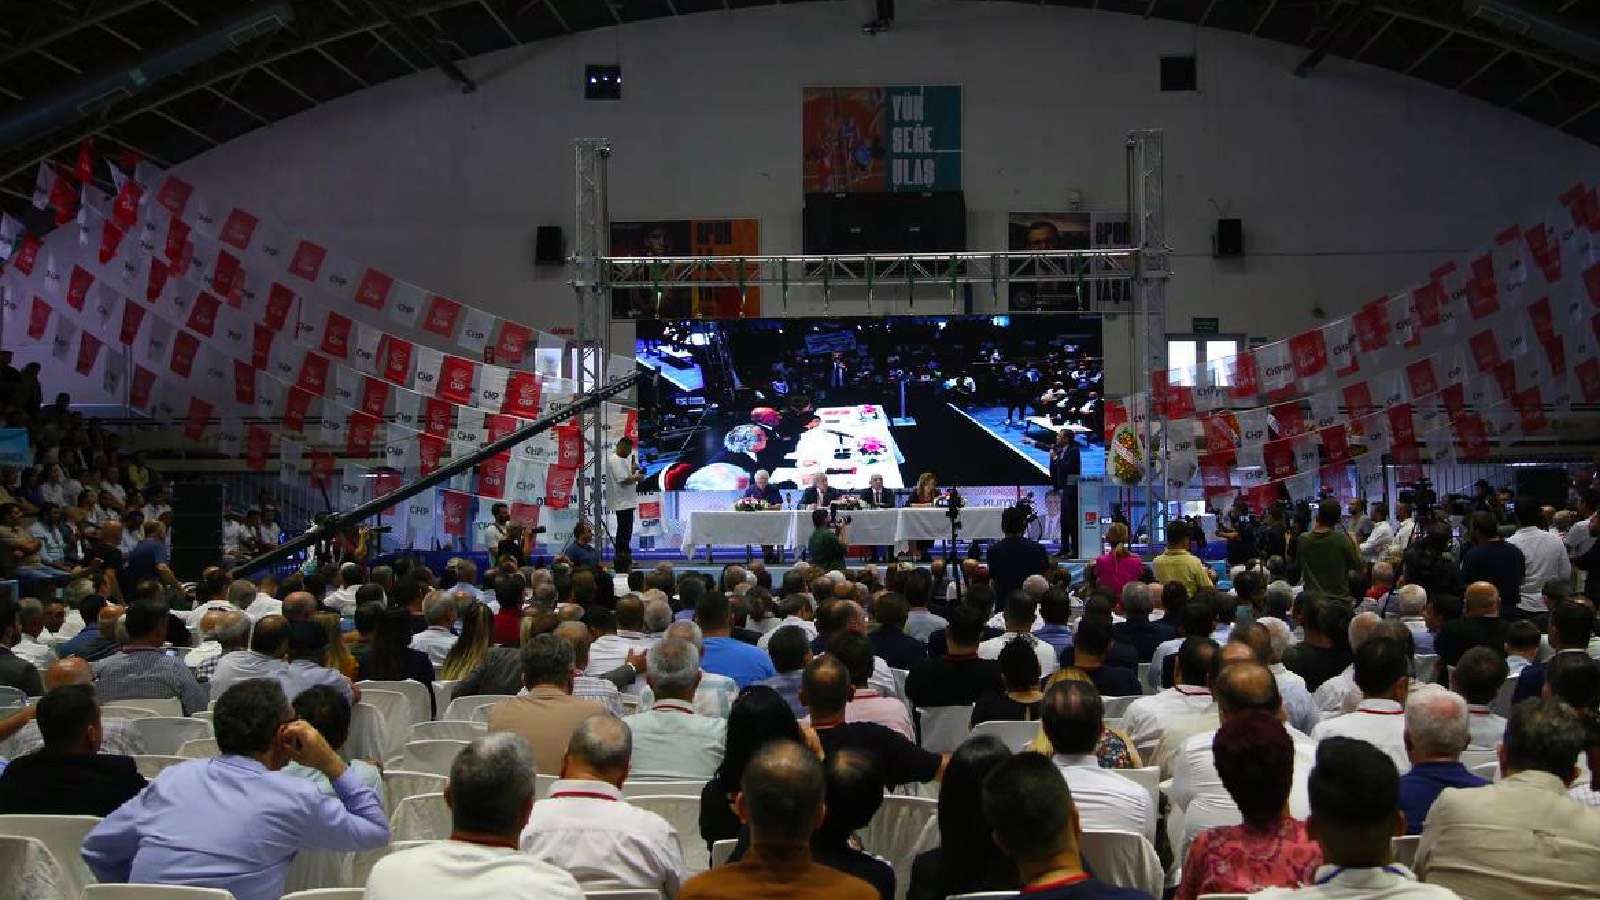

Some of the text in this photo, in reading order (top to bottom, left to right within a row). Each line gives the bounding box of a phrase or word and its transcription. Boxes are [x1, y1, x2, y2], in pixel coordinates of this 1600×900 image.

[483, 390, 499, 400] CHP
[457, 431, 476, 441] CHP
[1245, 431, 1263, 440] CHP
[525, 446, 543, 455] CHP
[641, 519, 659, 528] CHP
